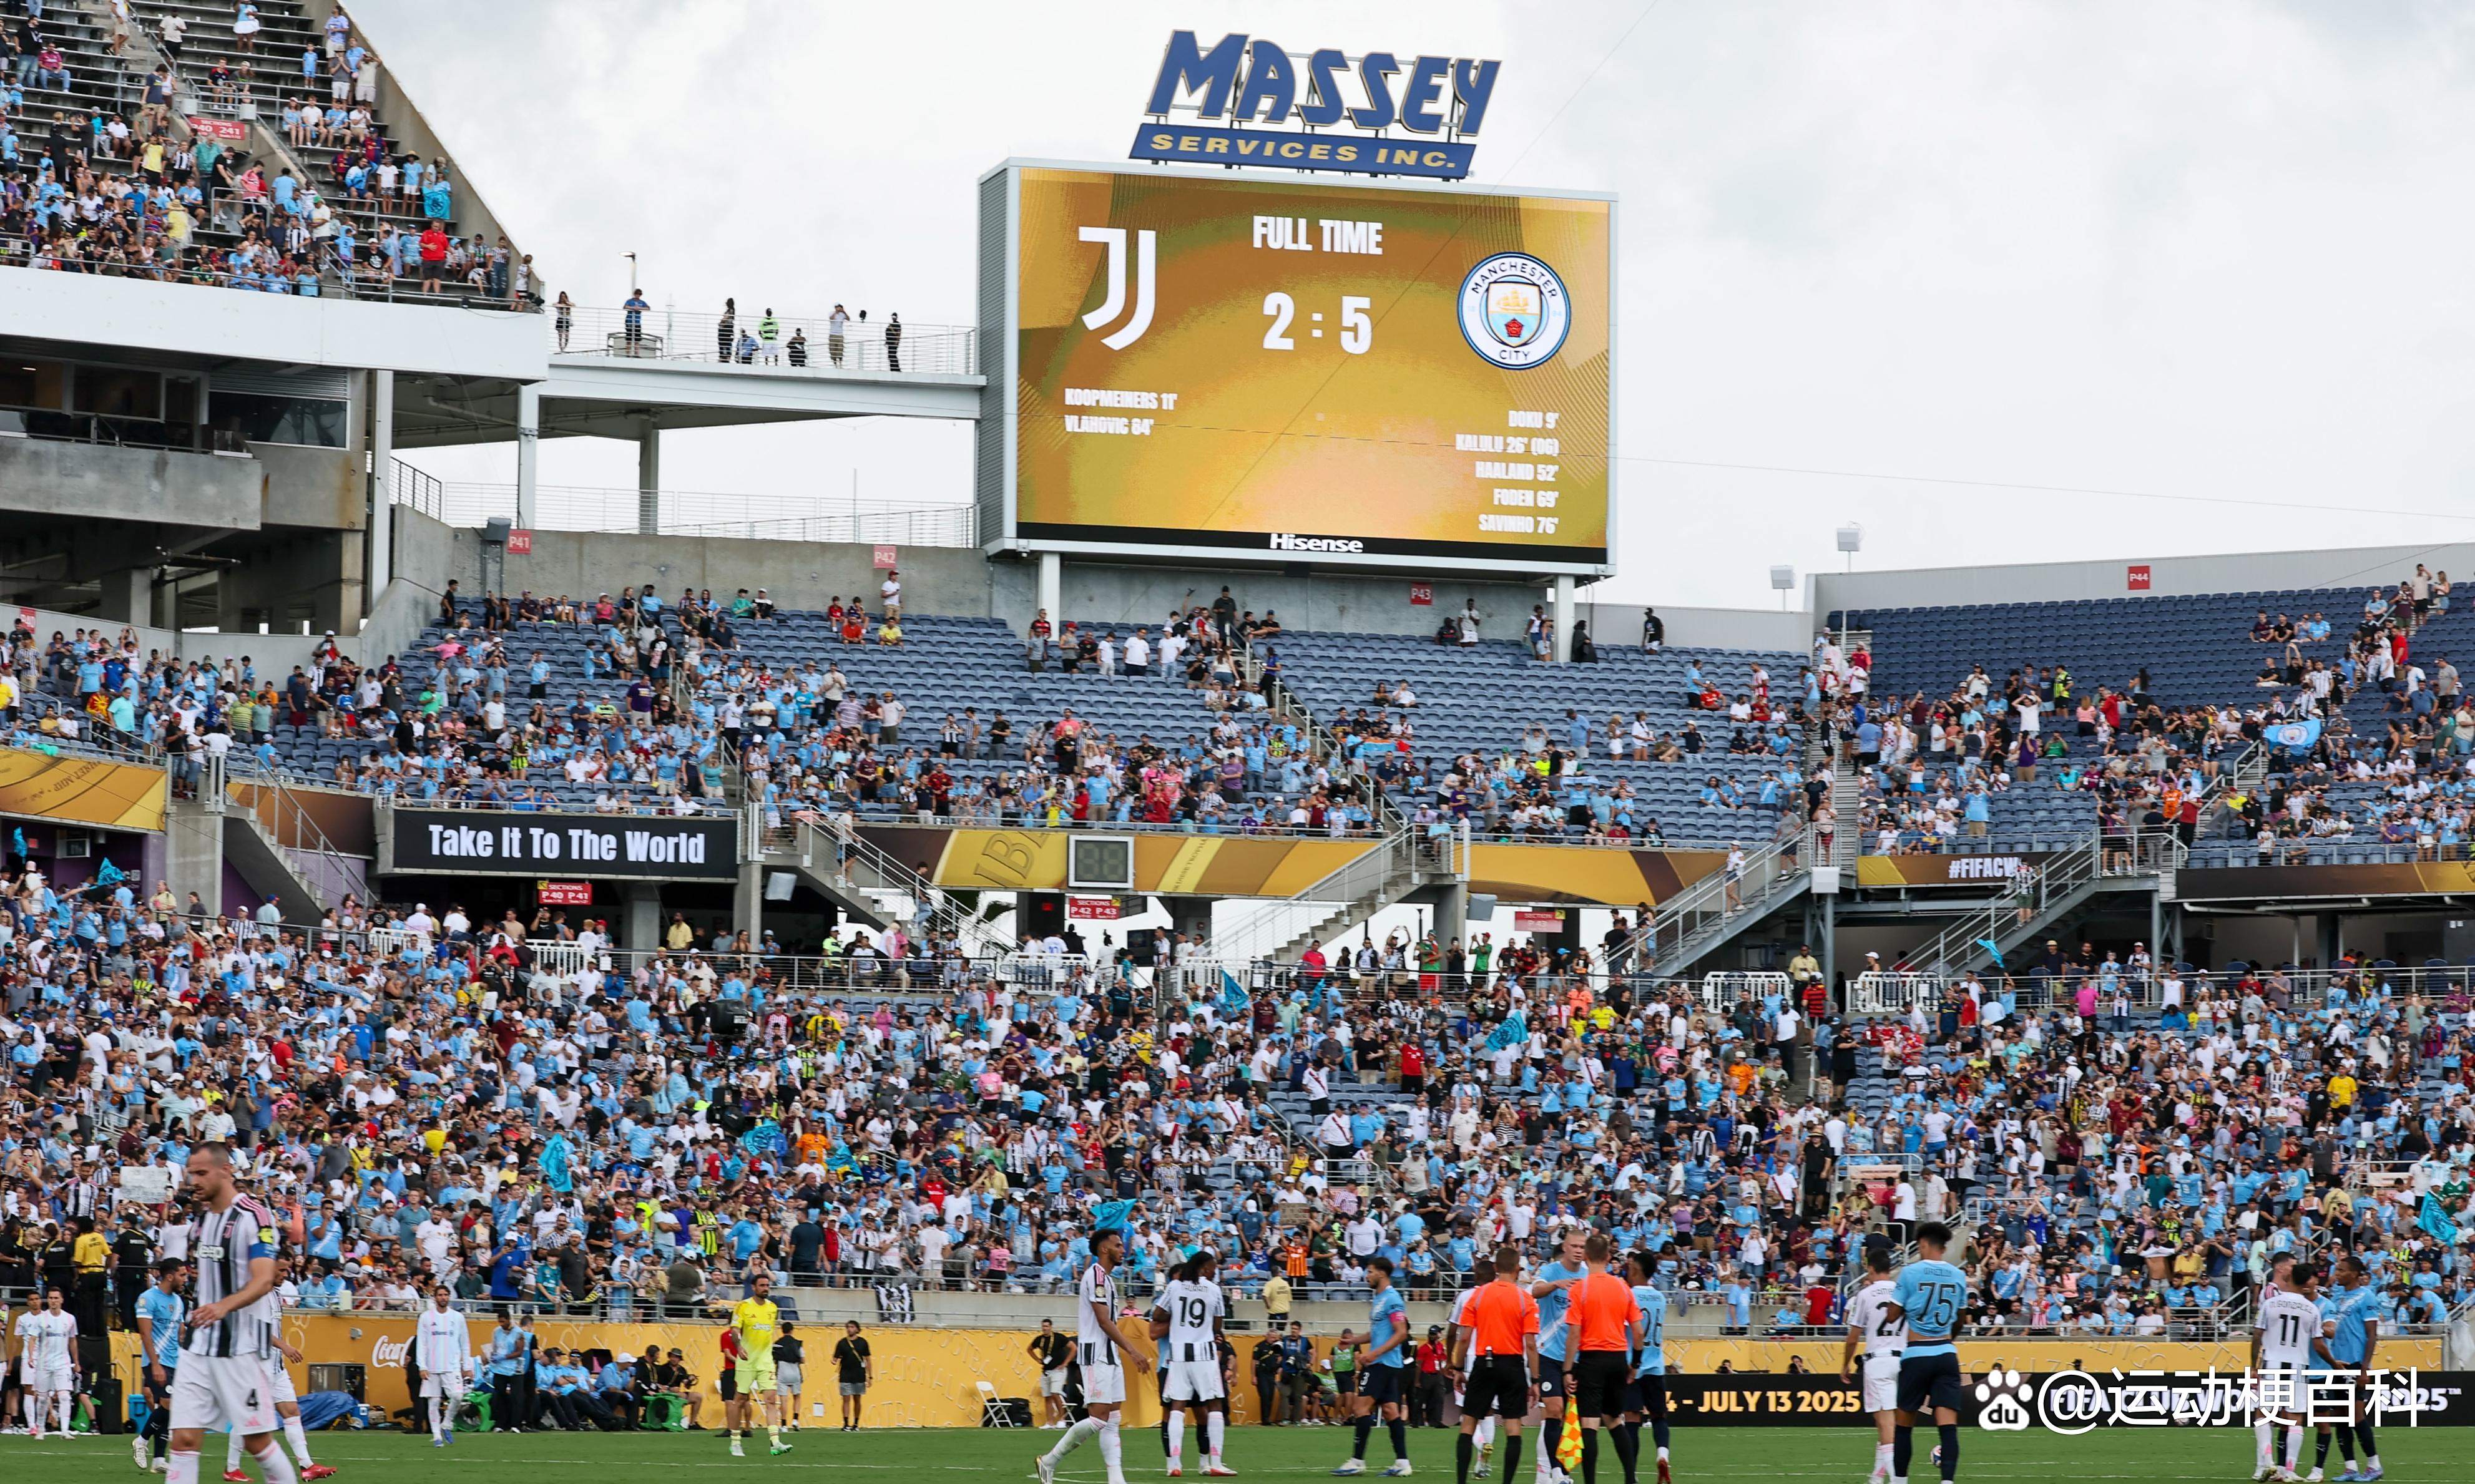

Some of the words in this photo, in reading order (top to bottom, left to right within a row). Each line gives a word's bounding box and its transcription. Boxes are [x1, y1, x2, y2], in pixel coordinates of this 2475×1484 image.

[1144, 29, 1502, 136] MASSEY
[1151, 134, 1358, 162] SERVICES
[1376, 149, 1456, 168] INC.
[1253, 215, 1313, 251] FULL
[1319, 219, 1383, 255] TIME
[1471, 261, 1557, 298] MANCHESTER
[1263, 292, 1295, 350] 2
[1340, 296, 1372, 354] 5
[1499, 350, 1529, 361] CITY
[1508, 411, 1543, 428] DOKU
[1456, 434, 1504, 452] KALULU
[1476, 461, 1534, 481] HAALAND
[1493, 489, 1534, 507] FODEN
[1479, 514, 1534, 533] SAVINHO
[509, 536, 529, 549] P41
[1270, 533, 1363, 553] Hisense
[875, 552, 895, 563] P42
[2130, 573, 2149, 582] P44
[1411, 588, 1431, 600] P43
[428, 824, 494, 857] Take
[502, 827, 522, 858] It
[529, 827, 560, 859] To
[568, 829, 617, 861] The
[625, 831, 705, 864] World
[1948, 857, 2021, 879] #FIFACW
[1178, 1296, 1206, 1329] 19
[1916, 1282, 1958, 1327] 75
[753, 1323, 772, 1331] Jeep
[2280, 1314, 2300, 1347] 11
[1360, 1372, 1370, 1385] 3
[246, 1389, 258, 1411] 4
[1698, 1391, 1762, 1412] JULY
[1766, 1391, 1792, 1412] 13
[1796, 1391, 1861, 1412] 2025
